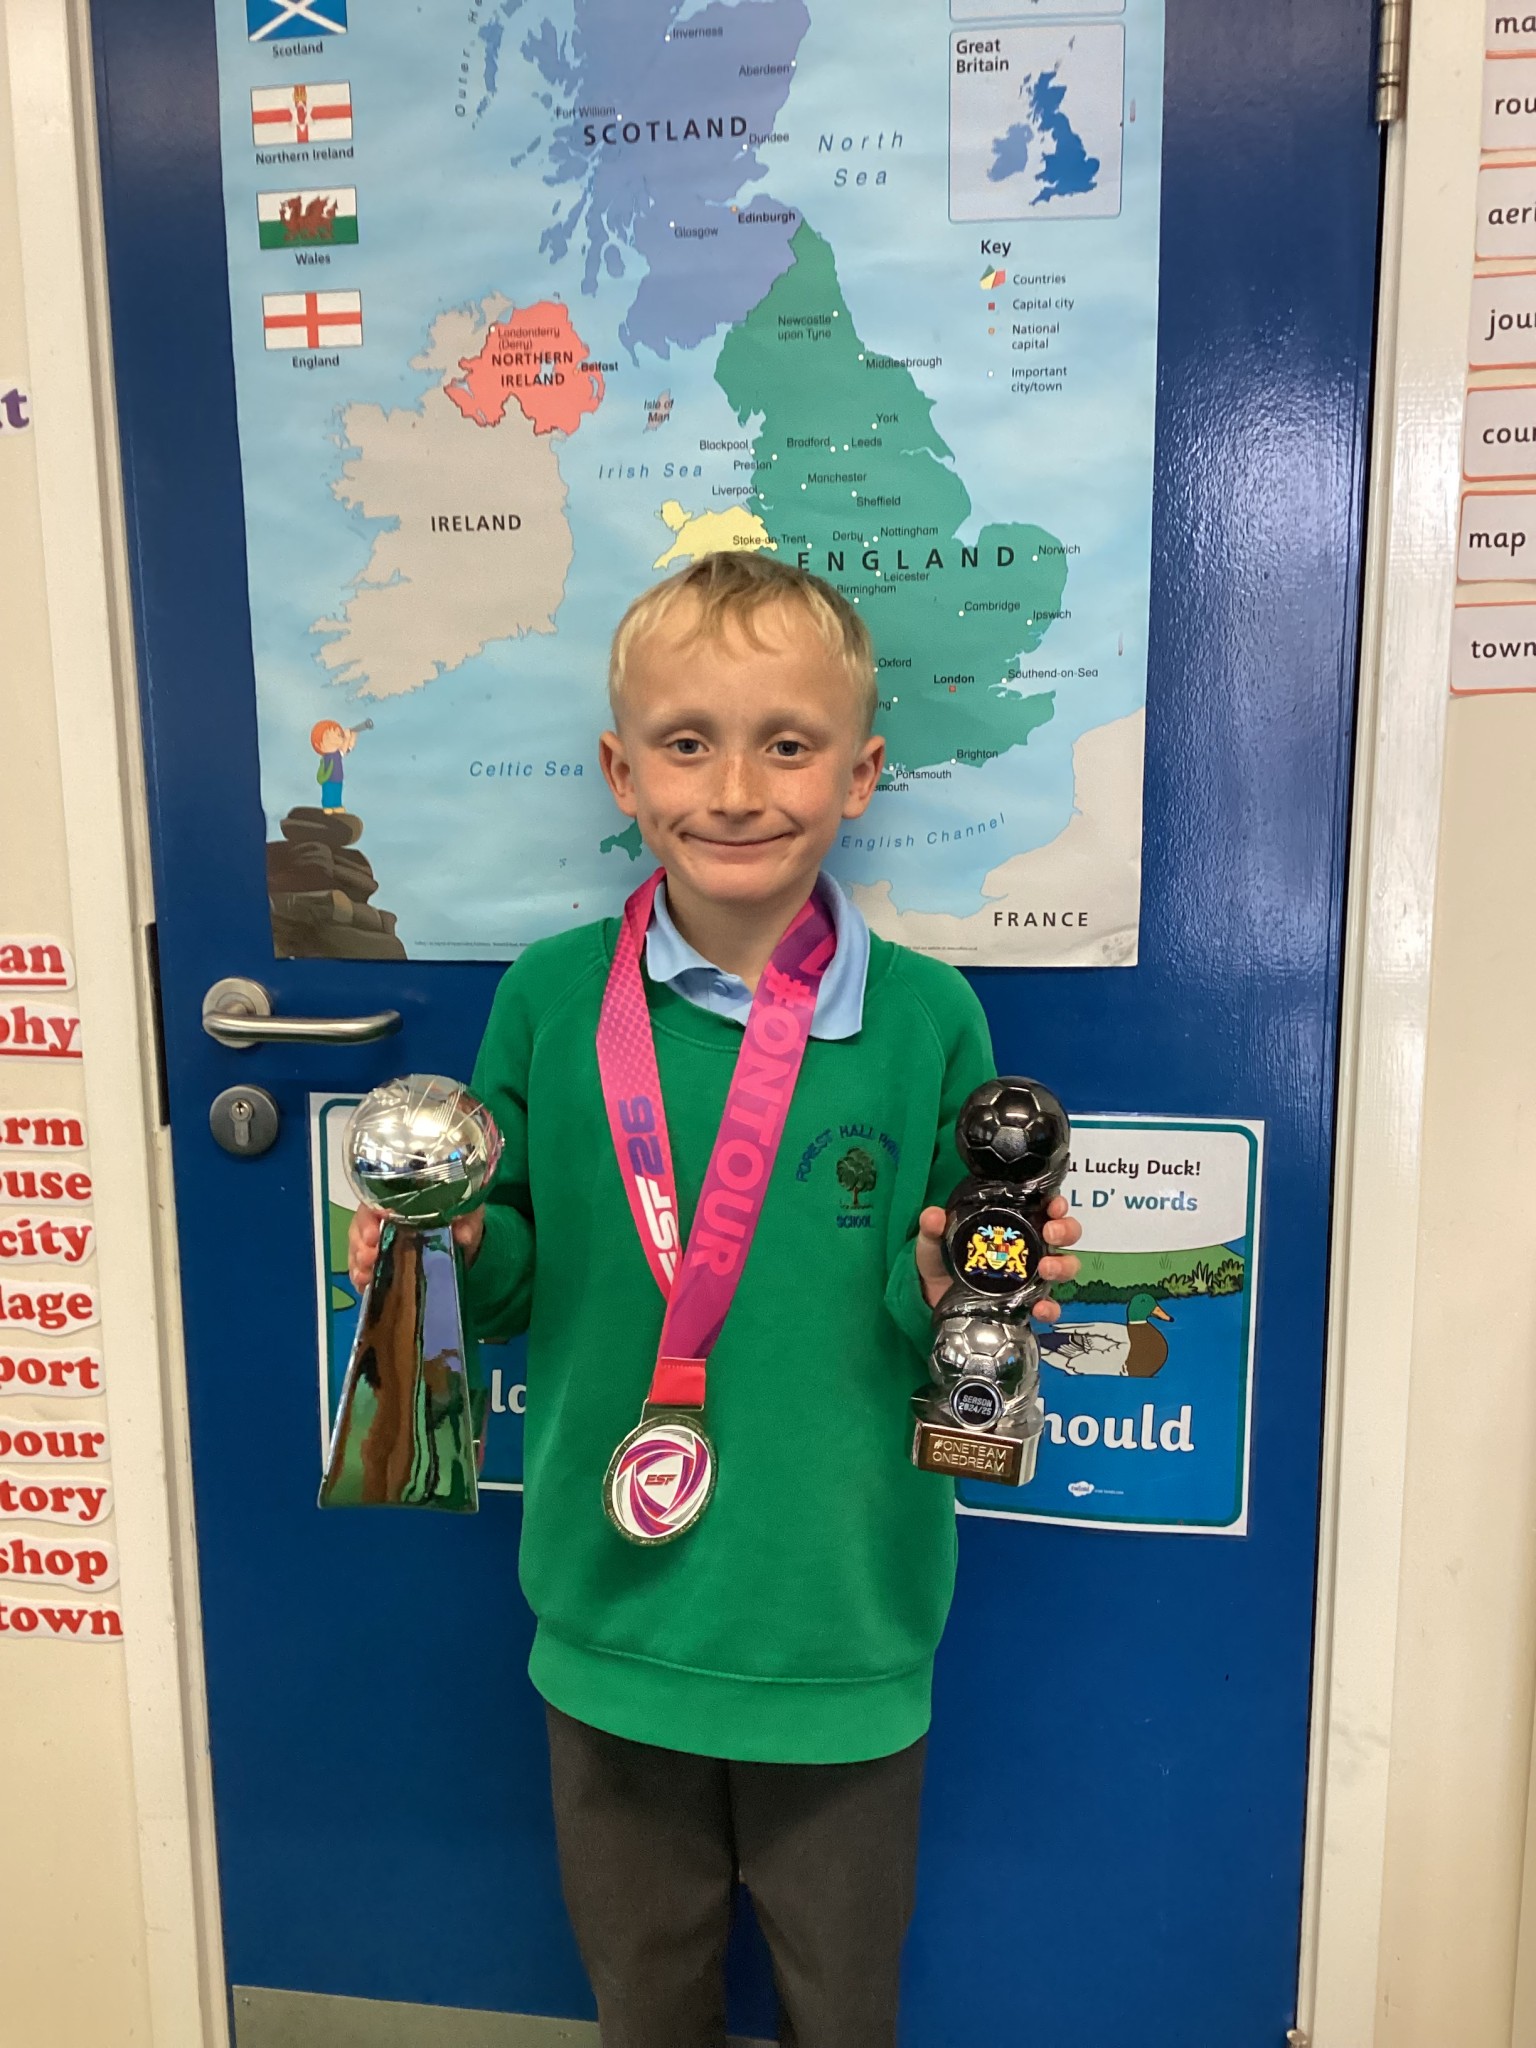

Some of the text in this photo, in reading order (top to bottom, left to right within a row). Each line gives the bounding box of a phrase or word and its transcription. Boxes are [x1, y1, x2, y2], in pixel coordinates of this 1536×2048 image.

[672, 27, 724, 39] Inverness
[272, 41, 324, 58] Scotland
[956, 39, 1001, 54] Great
[738, 63, 790, 77] Aberdeen
[956, 58, 1010, 73] Britain
[556, 105, 616, 119] Fort William
[582, 116, 748, 147] SCOTLAND
[748, 131, 790, 144] Dundee
[817, 130, 904, 154] North
[256, 146, 354, 165] Northern Ireland
[834, 168, 888, 188] Sea
[738, 210, 796, 225] Edinburgh
[674, 225, 719, 239] Glasgow
[980, 239, 1012, 257] Key
[295, 253, 331, 266] Wales
[1013, 273, 1067, 286] Countries
[1012, 297, 1075, 312] Capital city
[778, 314, 832, 327] Newcastle
[1485, 308, 1536, 341] jou
[498, 326, 561, 339] Londonderry
[777, 328, 832, 342] upon Tyne
[1012, 322, 1060, 335] National
[1012, 337, 1050, 351] capital
[292, 355, 340, 370] England
[491, 351, 574, 367] NORTHERN
[866, 356, 943, 370] Middlesbrough
[580, 361, 620, 373] Belfast
[1011, 366, 1068, 380] Important
[501, 373, 566, 388] IRELAND
[1011, 381, 1064, 394] city/town
[644, 400, 662, 412] Isle
[647, 412, 671, 423] Man
[875, 413, 900, 424] York
[1482, 425, 1536, 444] cou
[699, 440, 749, 452] Blackpool
[786, 437, 831, 448] Bradford
[851, 437, 883, 448] Leeds
[598, 462, 703, 479] Irish Sea
[806, 472, 868, 484] Manchester
[711, 485, 758, 498] Liverpool
[856, 496, 902, 508] Sheffield
[430, 514, 523, 533] IRELAND
[832, 531, 864, 543] Derby
[880, 525, 939, 538] Nottingham
[732, 533, 807, 546] Stoke-on-Trent
[1468, 531, 1527, 556] map
[1038, 543, 1081, 556] Norwich
[796, 546, 1016, 573] ENGLAND
[883, 571, 931, 582] Leicester
[836, 584, 897, 597] Birmingham
[963, 600, 1021, 613] Cambridge
[1032, 609, 1072, 622] Ipswich
[1471, 640, 1536, 659] town
[878, 658, 912, 669] Oxford
[933, 674, 975, 684] London
[1008, 667, 1099, 680] Southend-on-Sea
[956, 748, 999, 761] Brighton
[469, 761, 585, 777] Celtic Sea
[895, 769, 952, 780] Portsmouth
[841, 812, 1006, 851] English Channel
[993, 911, 1089, 928] FRANCE
[0, 944, 65, 973] an
[0, 1117, 84, 1146] rm
[1085, 1158, 1140, 1179] Lucky
[1147, 1159, 1202, 1176] Duck!
[0, 1170, 92, 1200] use
[1071, 1190, 1083, 1208] L
[1124, 1190, 1199, 1212] words
[962, 1394, 994, 1408] SEASON
[958, 1402, 994, 1417] 2024/25
[1032, 1397, 1196, 1453] hould
[933, 1438, 1008, 1462] #ONETEAM
[931, 1451, 1006, 1474] ONEDREAM
[644, 1474, 678, 1487] ESF
